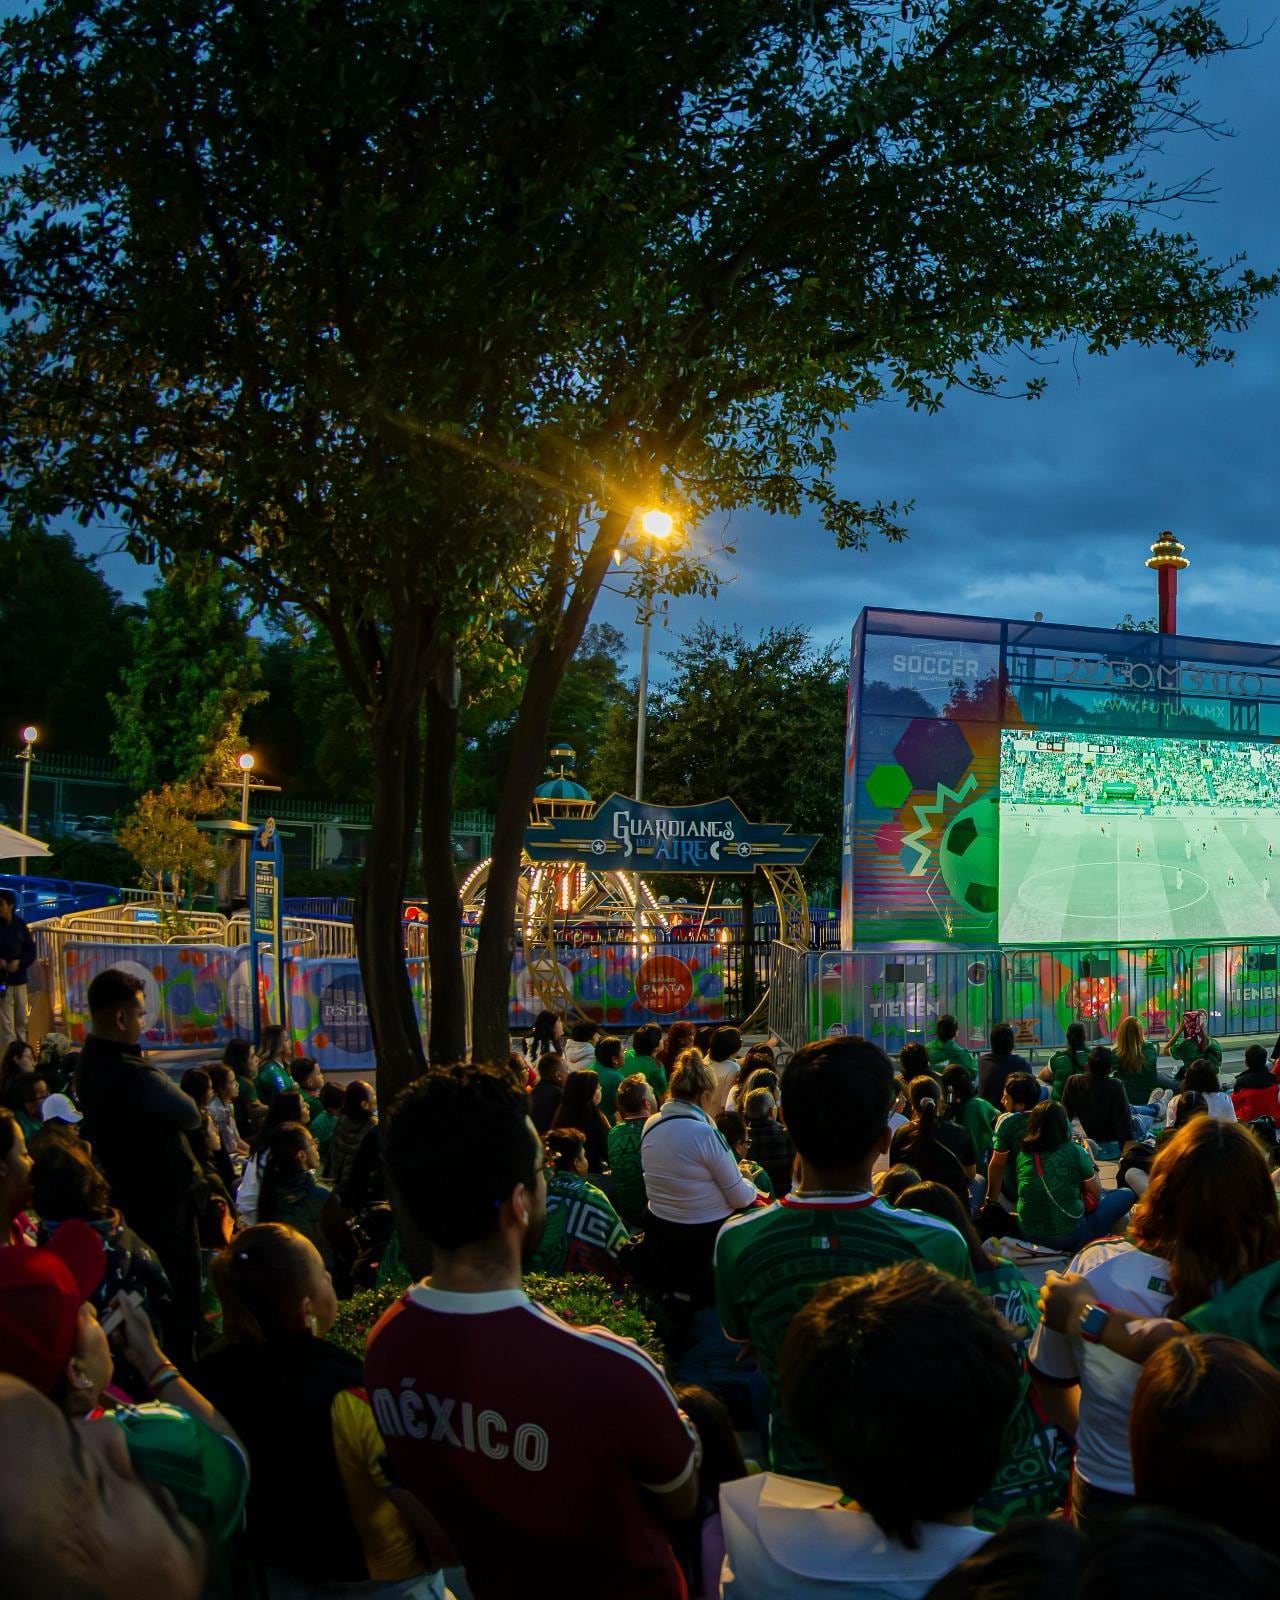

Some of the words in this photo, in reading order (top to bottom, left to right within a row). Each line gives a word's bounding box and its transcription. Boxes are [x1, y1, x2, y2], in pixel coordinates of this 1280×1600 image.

[893, 654, 979, 677] SOCCER
[613, 810, 735, 848] GUARDIANES
[653, 840, 709, 867] AIRE
[642, 983, 686, 993] PLATA
[372, 1376, 550, 1473] MÉXICO
